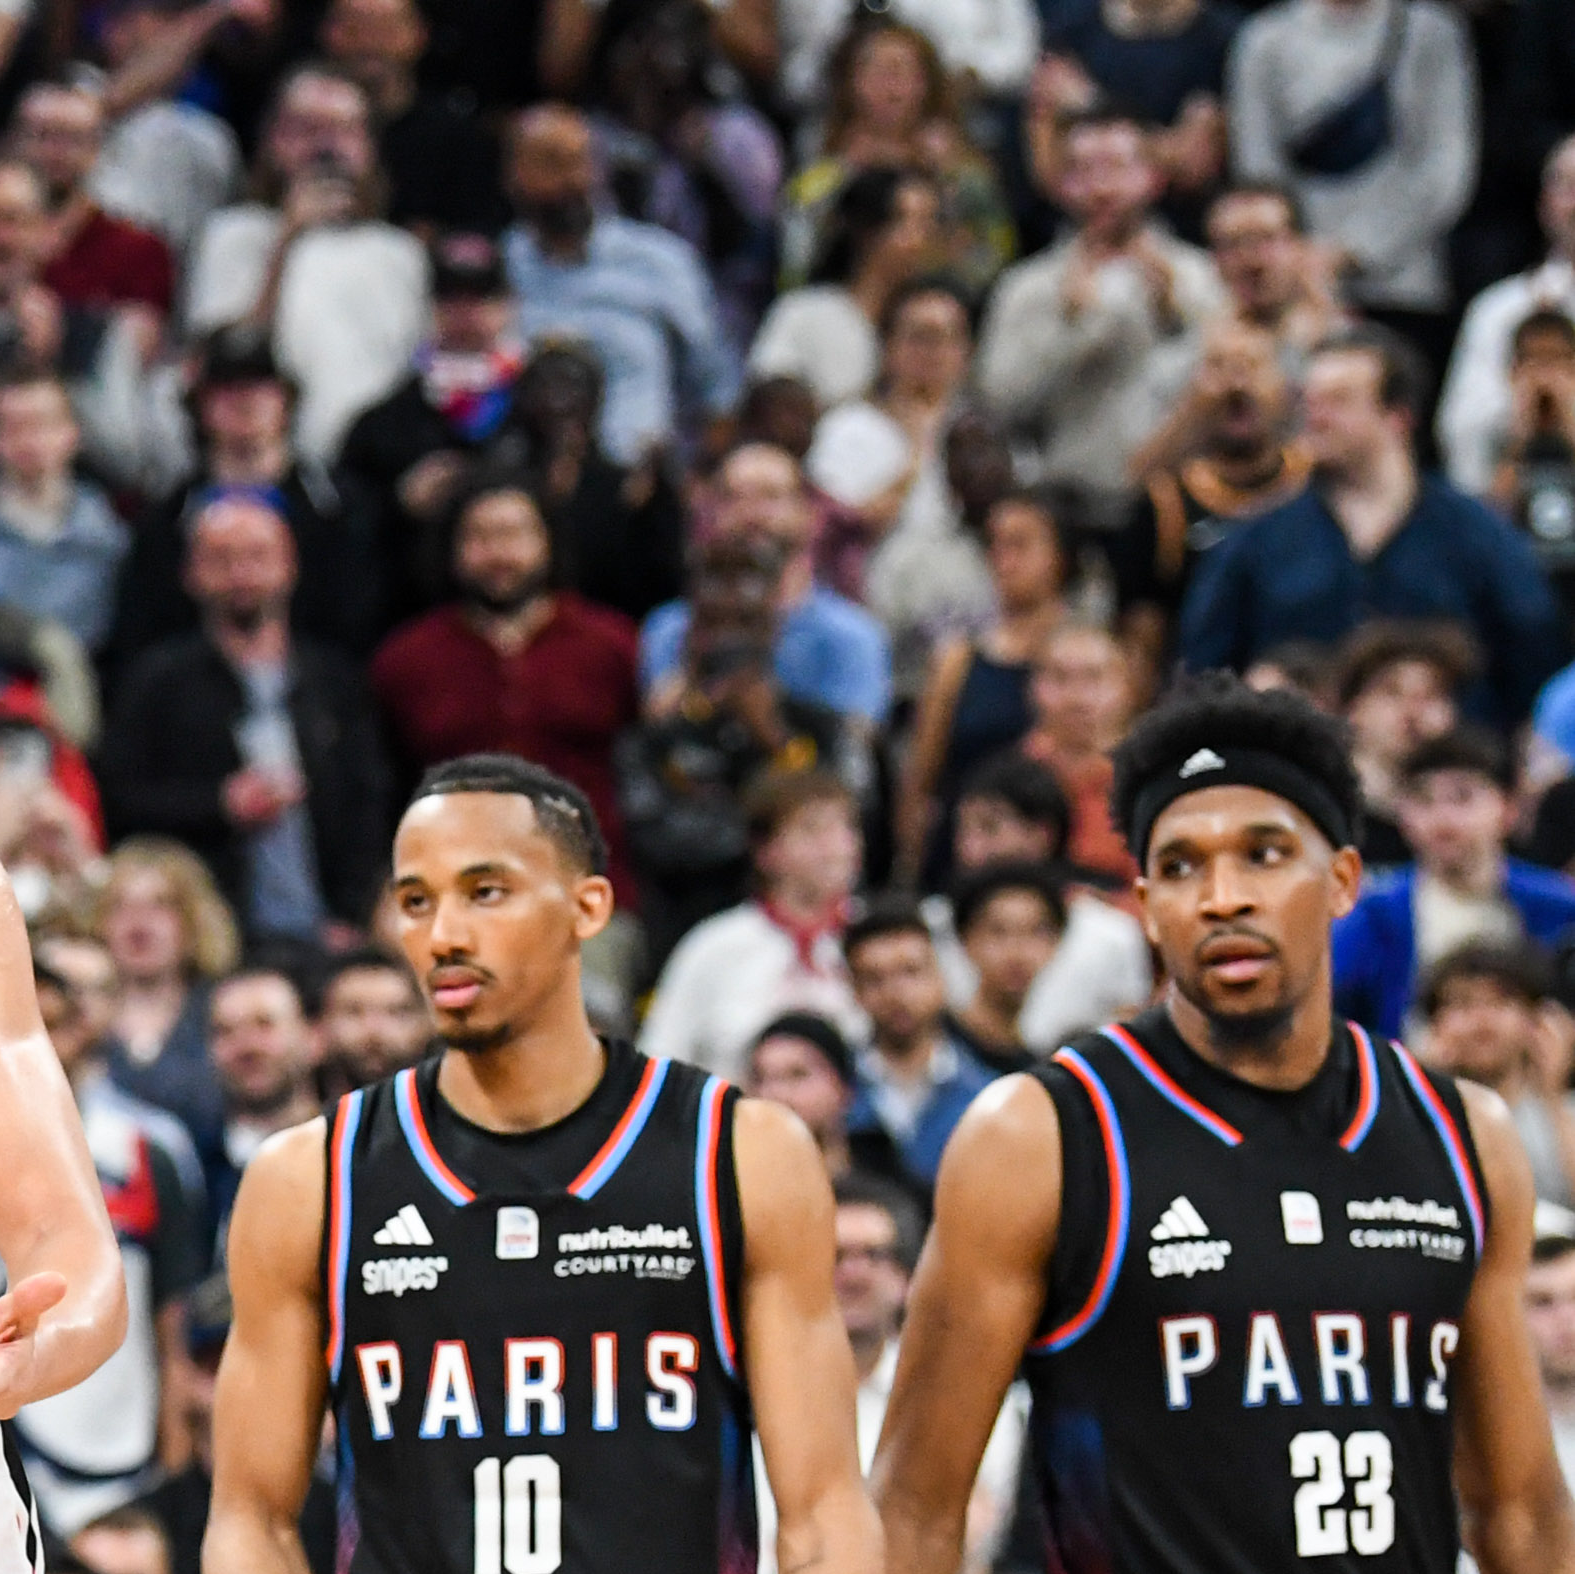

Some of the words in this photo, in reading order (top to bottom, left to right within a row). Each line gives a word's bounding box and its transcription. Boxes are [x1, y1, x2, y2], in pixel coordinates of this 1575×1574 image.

[354, 1331, 701, 1441] PARIS
[1158, 1310, 1460, 1412] PARIS
[1288, 1430, 1396, 1558] 23
